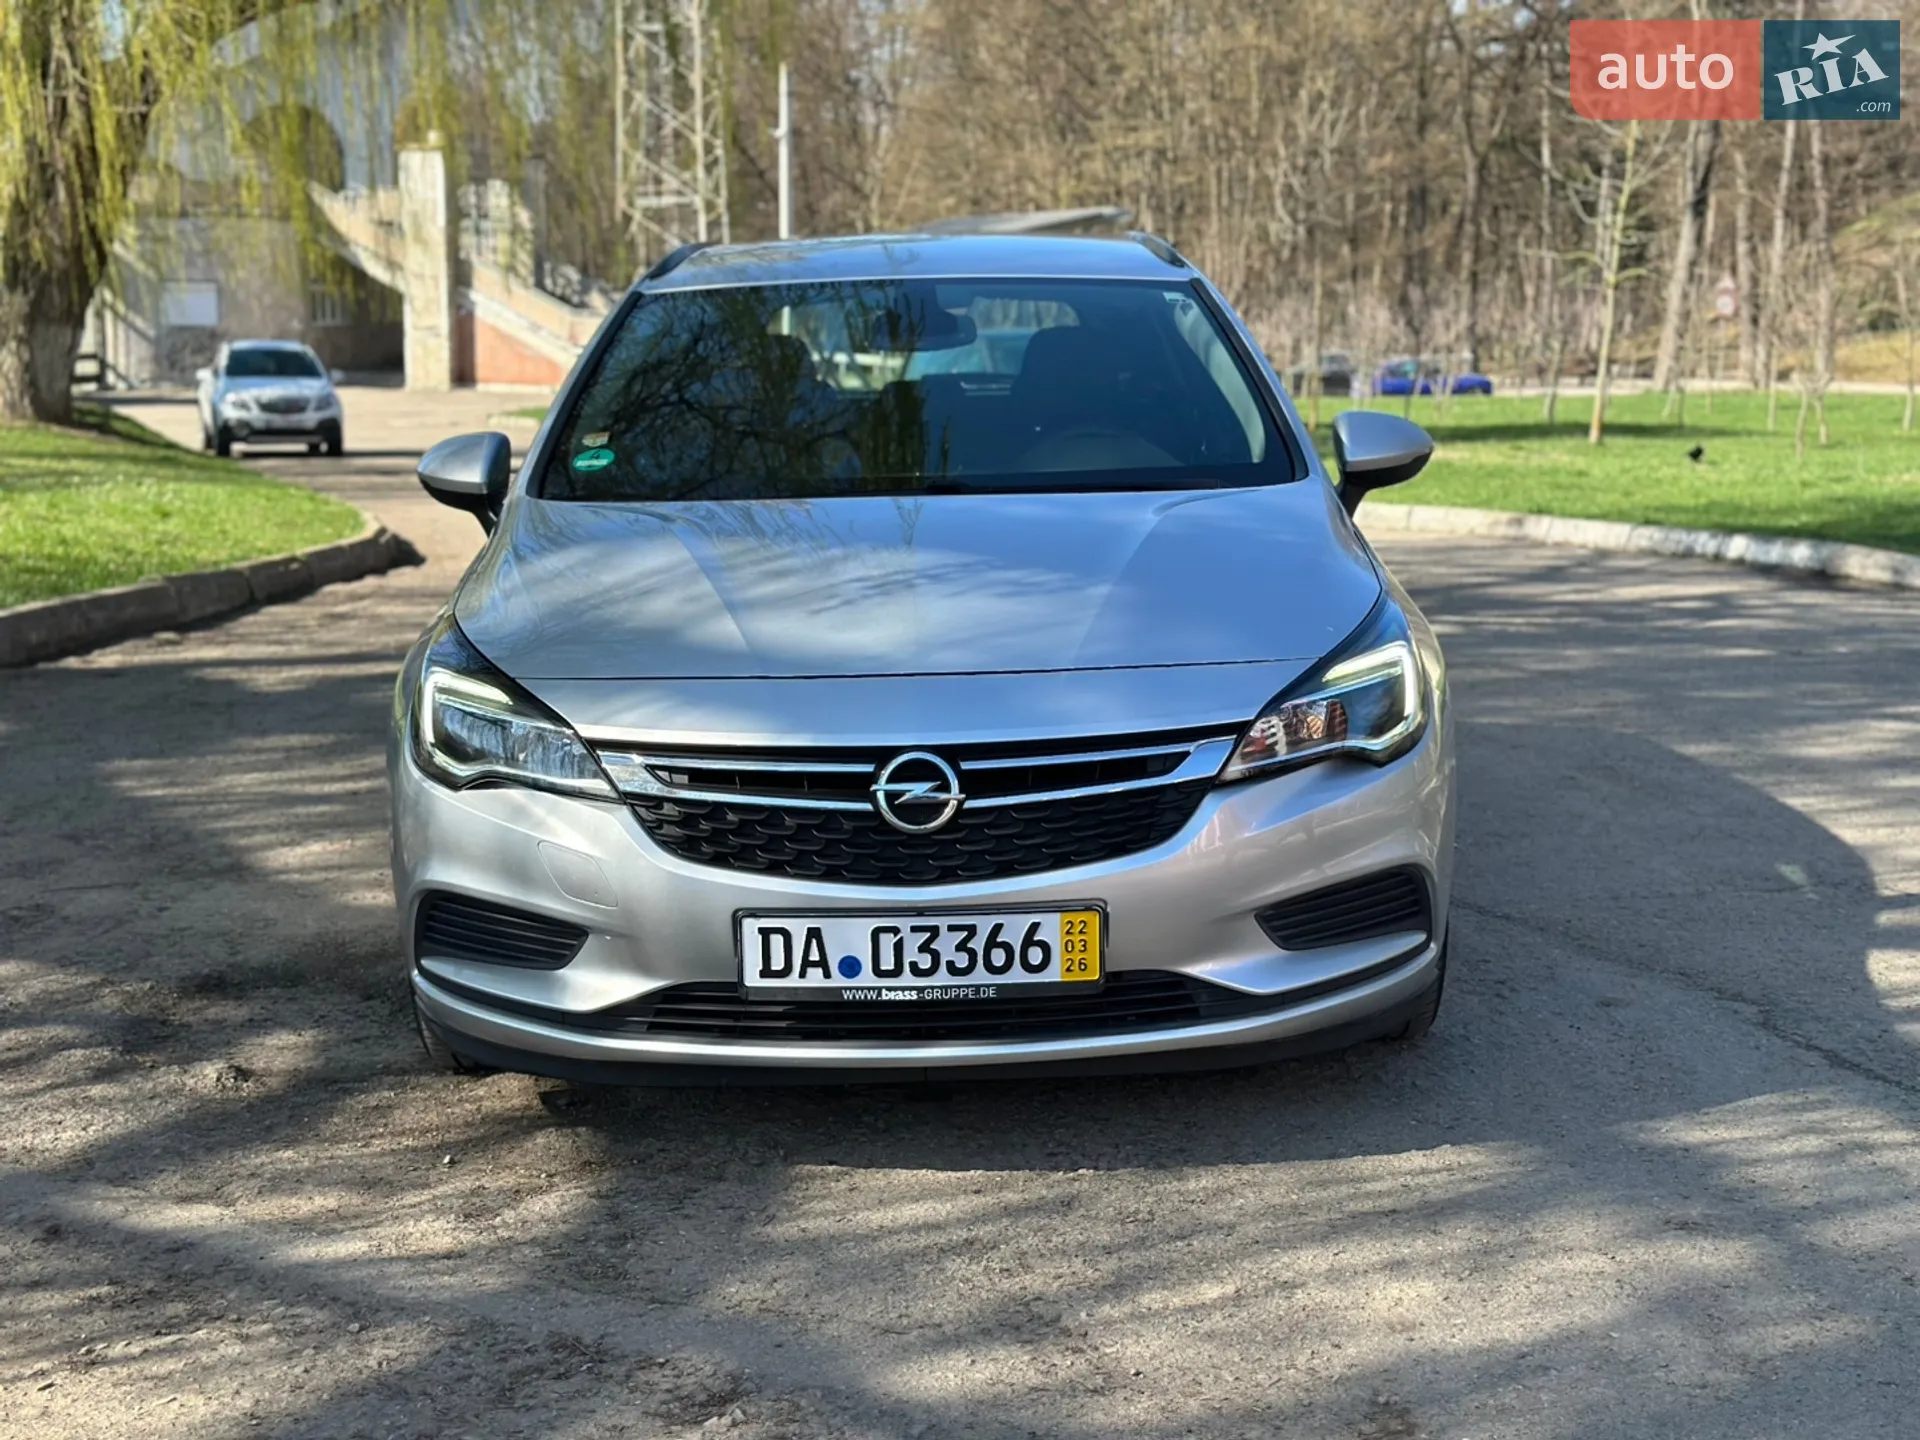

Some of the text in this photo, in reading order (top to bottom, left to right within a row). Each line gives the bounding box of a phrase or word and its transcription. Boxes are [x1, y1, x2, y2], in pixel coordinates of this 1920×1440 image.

[1064, 919, 1088, 936] 22
[757, 920, 1051, 979] DA 03366
[1064, 939, 1088, 954] 03
[1064, 957, 1088, 973] 26
